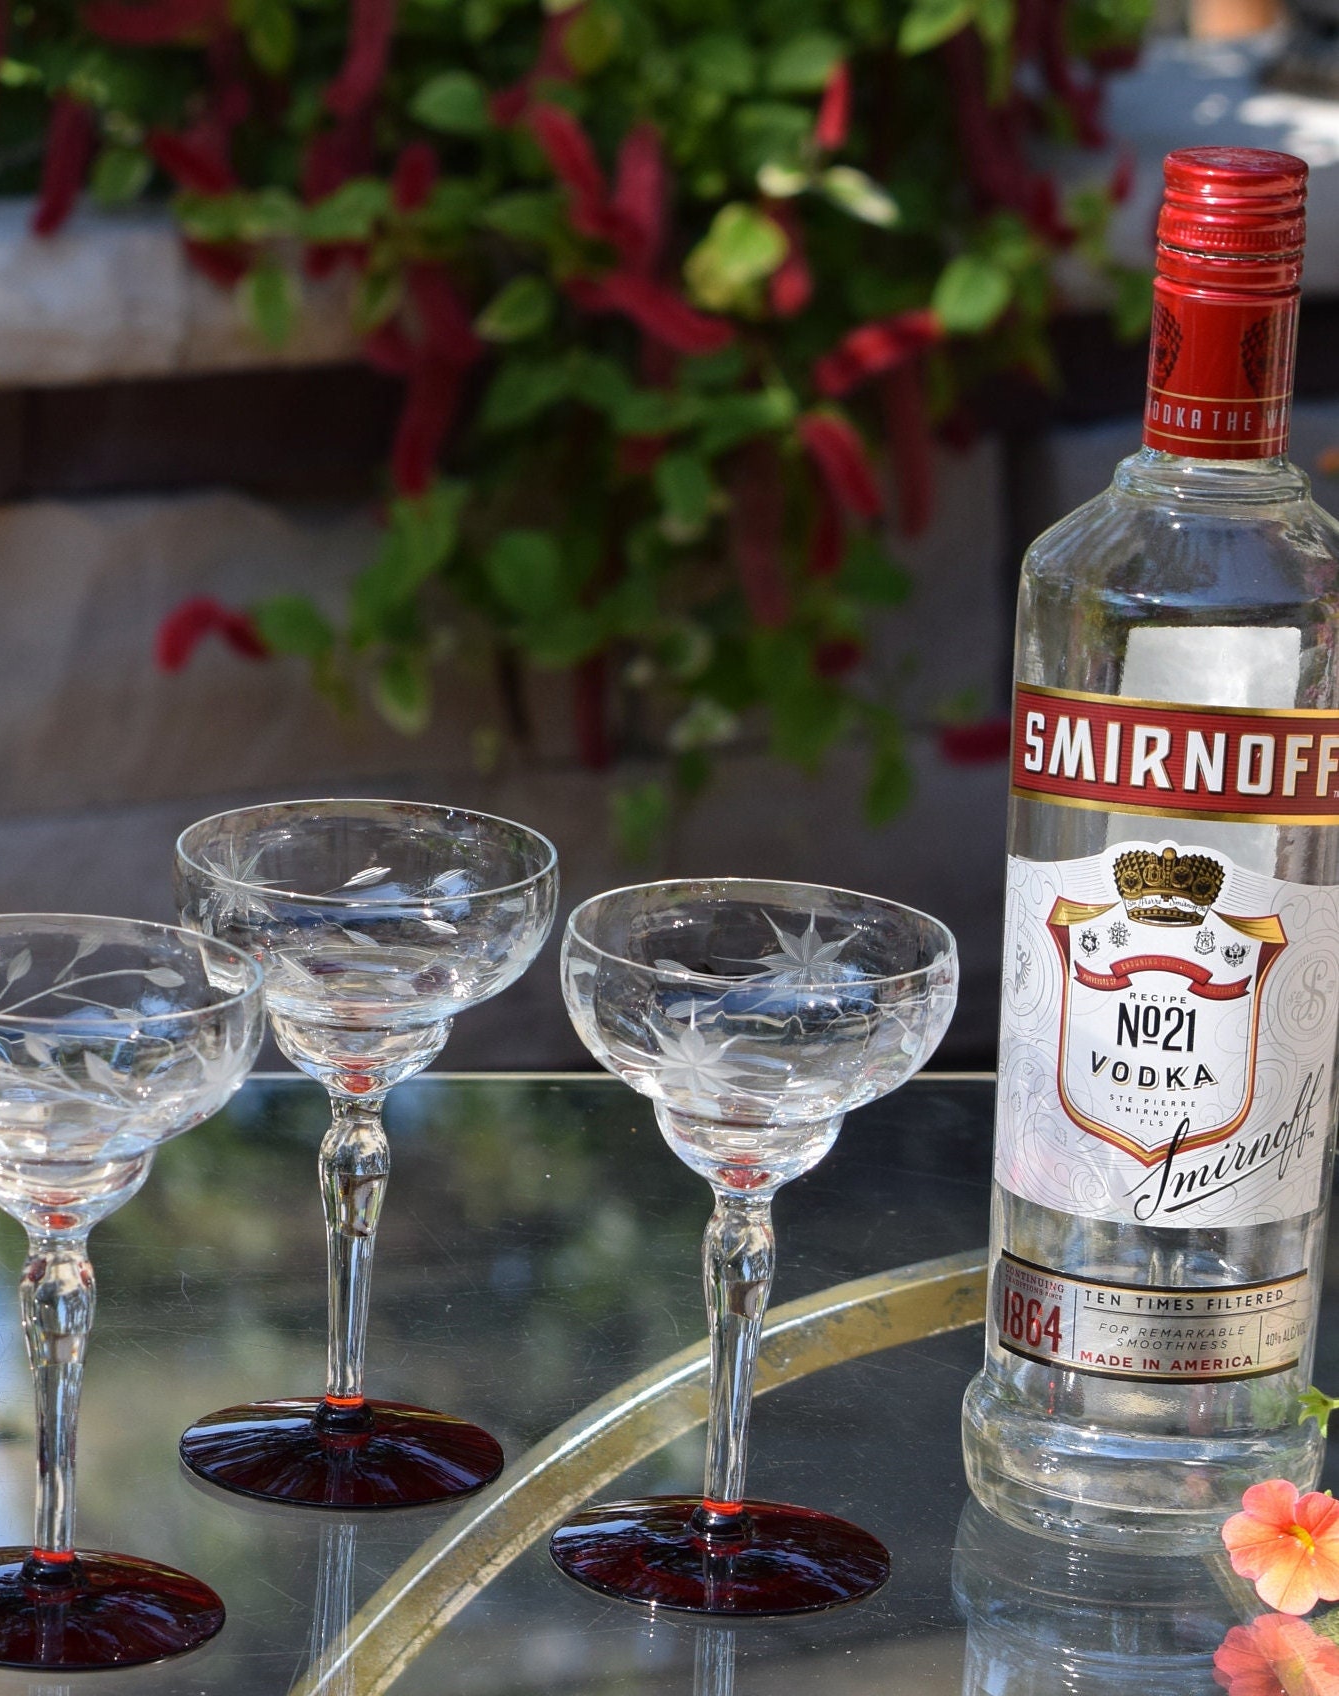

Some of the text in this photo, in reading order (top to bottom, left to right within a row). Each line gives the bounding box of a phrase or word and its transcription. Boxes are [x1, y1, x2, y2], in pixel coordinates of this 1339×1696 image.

[1212, 410, 1252, 431] THE
[1023, 710, 1339, 799] SMIRNOFF
[1129, 992, 1188, 1004] RECIPE
[1091, 1050, 1218, 1091] VODKA
[1110, 1094, 1196, 1107] STE PIERRE
[1116, 1106, 1189, 1117] SMIRNOFF
[1140, 1118, 1164, 1126] FLS
[1122, 1063, 1325, 1220] Smirnoff
[1005, 1263, 1064, 1293] CONTINUING
[1084, 1289, 1283, 1310] TEN TIMES FILTERED
[1003, 1285, 1063, 1353] 1864
[1099, 1322, 1247, 1339] FOR REMARKABLE
[1116, 1337, 1229, 1350] SMOOTHNESS
[1080, 1349, 1254, 1371] MADE IN AMERICA
